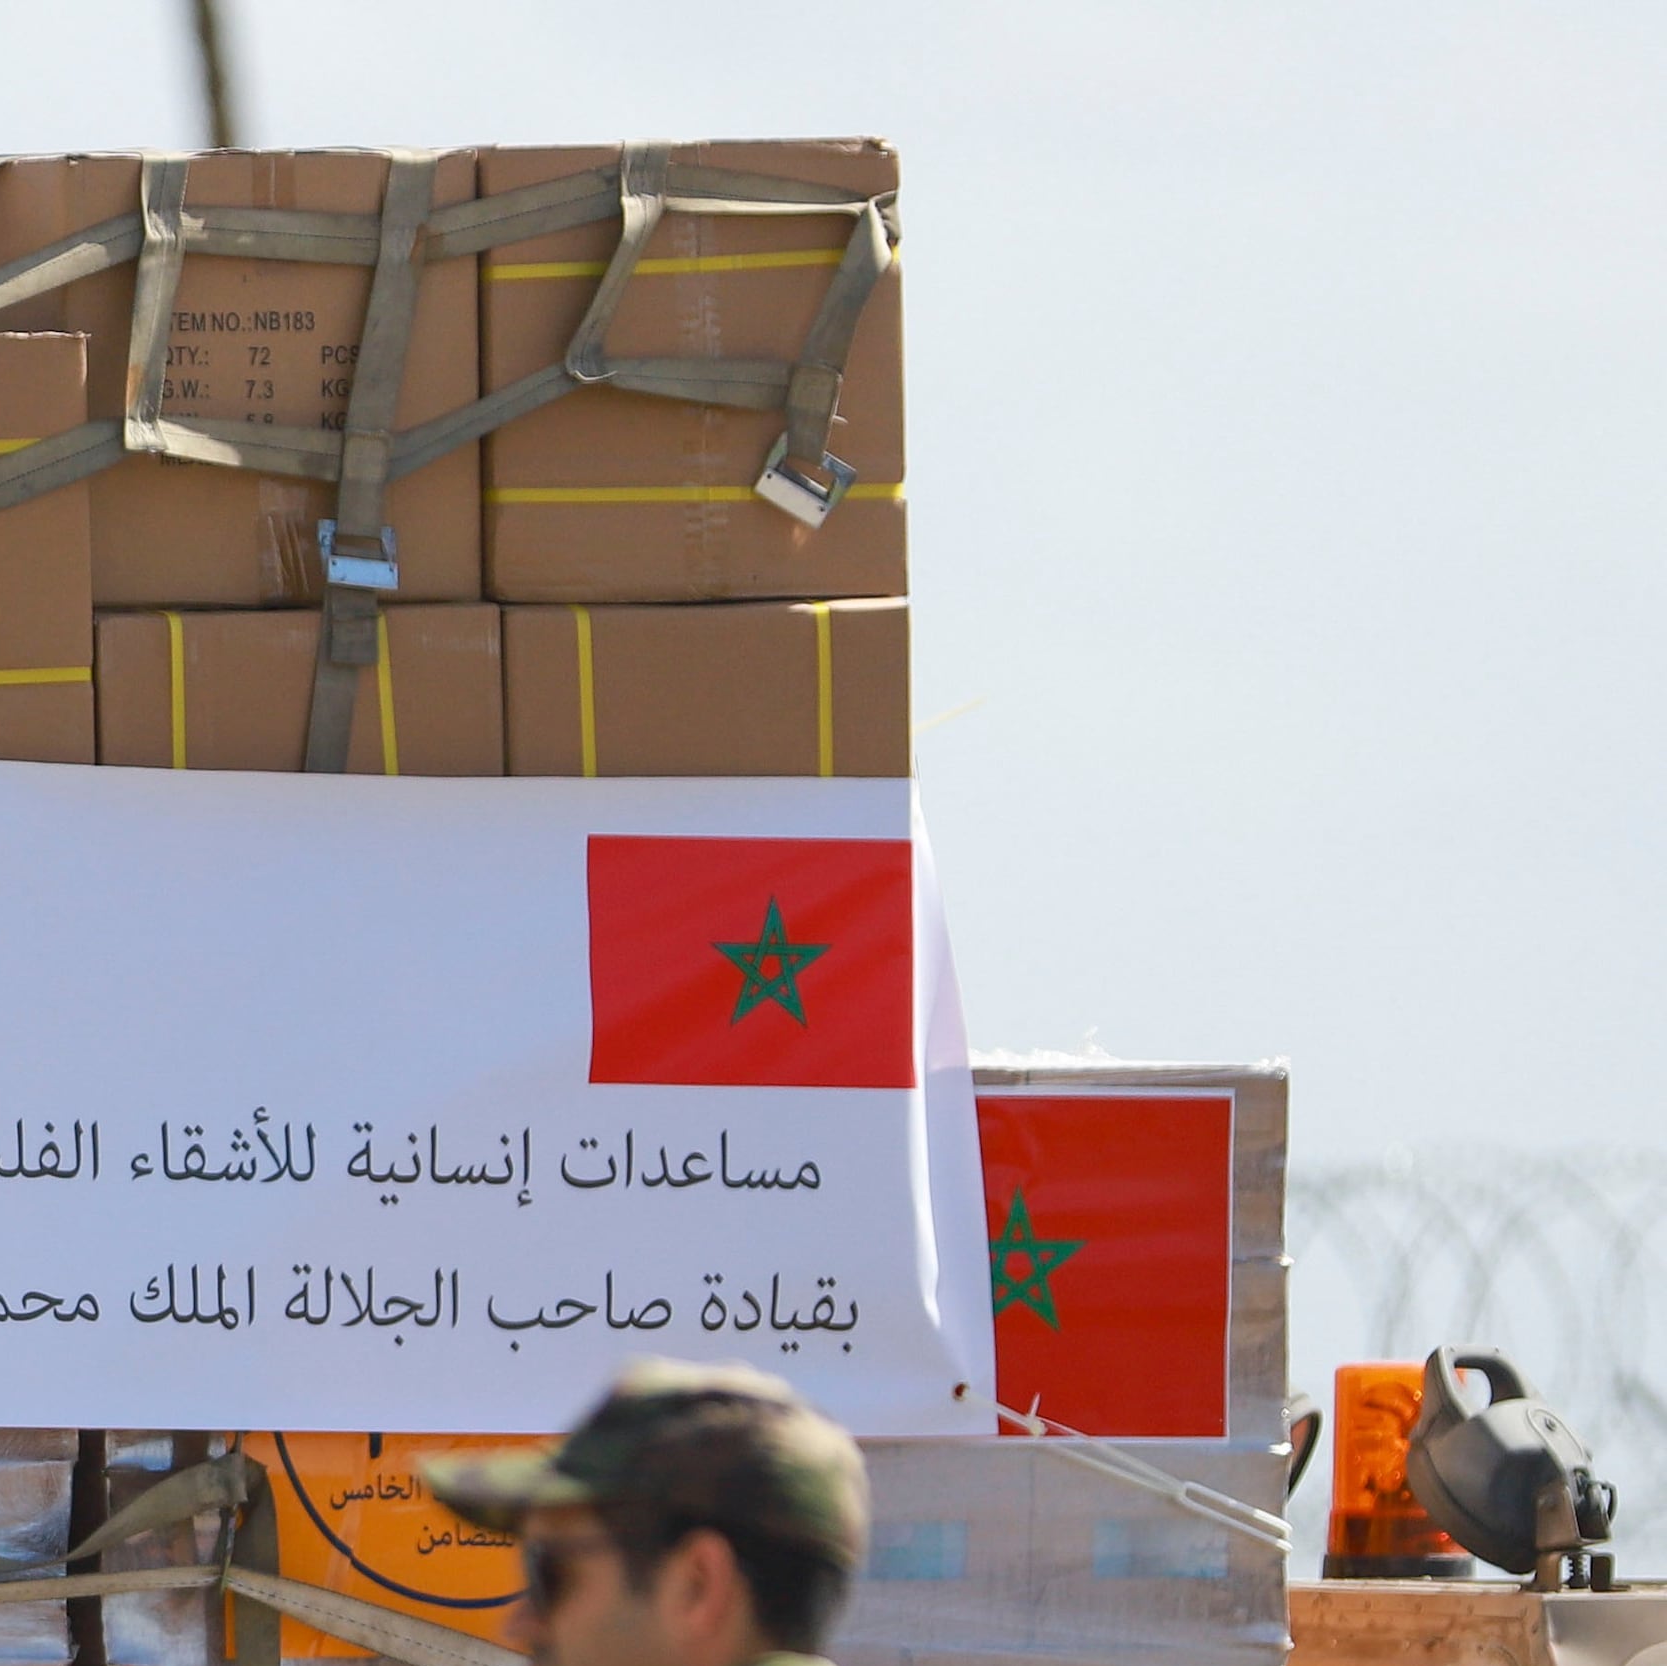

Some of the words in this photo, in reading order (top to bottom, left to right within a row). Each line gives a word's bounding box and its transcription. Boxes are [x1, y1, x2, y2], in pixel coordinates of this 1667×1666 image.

[169, 311, 207, 333] TEM
[248, 346, 272, 366] 72
[244, 379, 275, 399] 7.3
[130, 1105, 316, 1183] للأشقاء
[346, 1120, 533, 1207] إنسانية
[560, 1128, 821, 1190] مساعدات
[129, 1262, 255, 1331] الملك
[284, 1262, 459, 1347] الجلالة
[487, 1269, 672, 1352] صاحب
[700, 1271, 859, 1354] بقيادة
